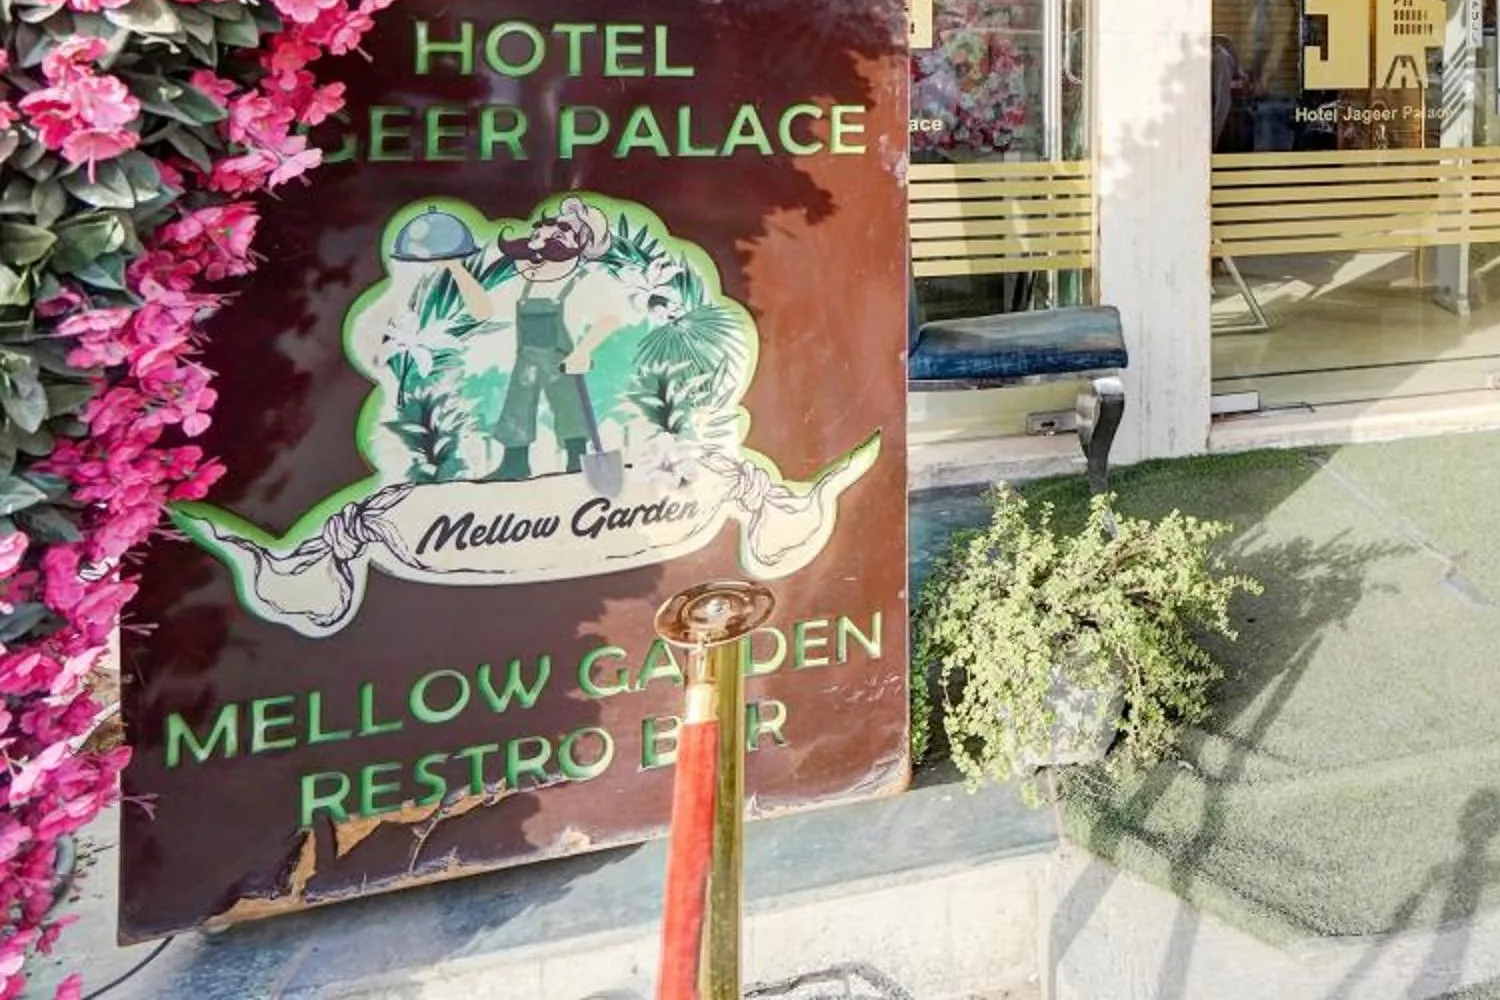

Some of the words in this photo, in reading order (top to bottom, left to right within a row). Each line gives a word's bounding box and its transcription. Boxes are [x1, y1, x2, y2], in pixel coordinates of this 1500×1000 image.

[414, 19, 696, 79] HOTEL
[556, 103, 868, 161] PALACE
[1295, 107, 1338, 123] Hotel
[1343, 106, 1398, 125] Jageer
[415, 511, 560, 555] Mellow
[570, 496, 700, 540] Garden
[163, 654, 554, 769] MELLOW
[576, 610, 884, 697] GADEN
[299, 727, 615, 830] RESTRO
[639, 698, 790, 770] BR
